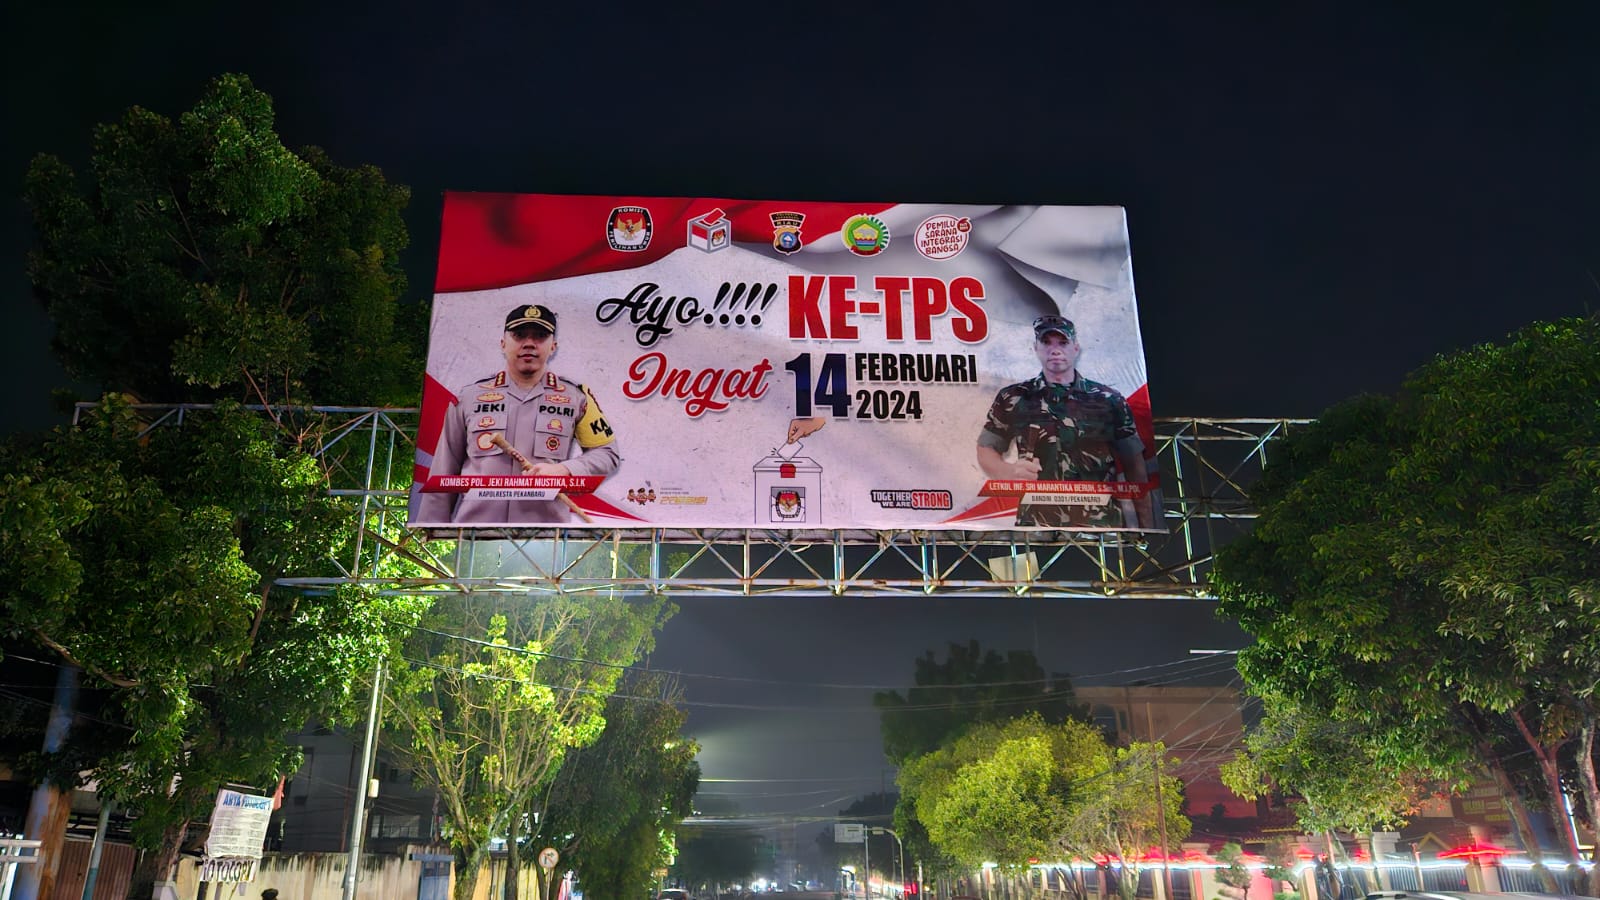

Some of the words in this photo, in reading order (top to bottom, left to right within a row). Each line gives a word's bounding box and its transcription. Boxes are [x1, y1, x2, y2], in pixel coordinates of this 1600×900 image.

[926, 220, 956, 230] PEMILU
[925, 228, 957, 238] SARANA
[921, 235, 963, 247] INTEGRASI
[925, 243, 959, 254] BANGSA
[788, 276, 988, 342] KE-TPS
[623, 352, 773, 417] Ingat
[785, 353, 852, 417] 14
[855, 353, 977, 383] FEBRUARI
[474, 403, 506, 413] JEKI
[856, 389, 924, 419] 2024
[539, 405, 575, 417] POLRI
[440, 477, 469, 487] KOMBES
[488, 477, 503, 487] JEKI
[504, 477, 533, 487] RAHMAT
[534, 478, 568, 489] MUSTIKA,
[872, 491, 912, 502] TOGETHER
[912, 493, 950, 508] STRONG
